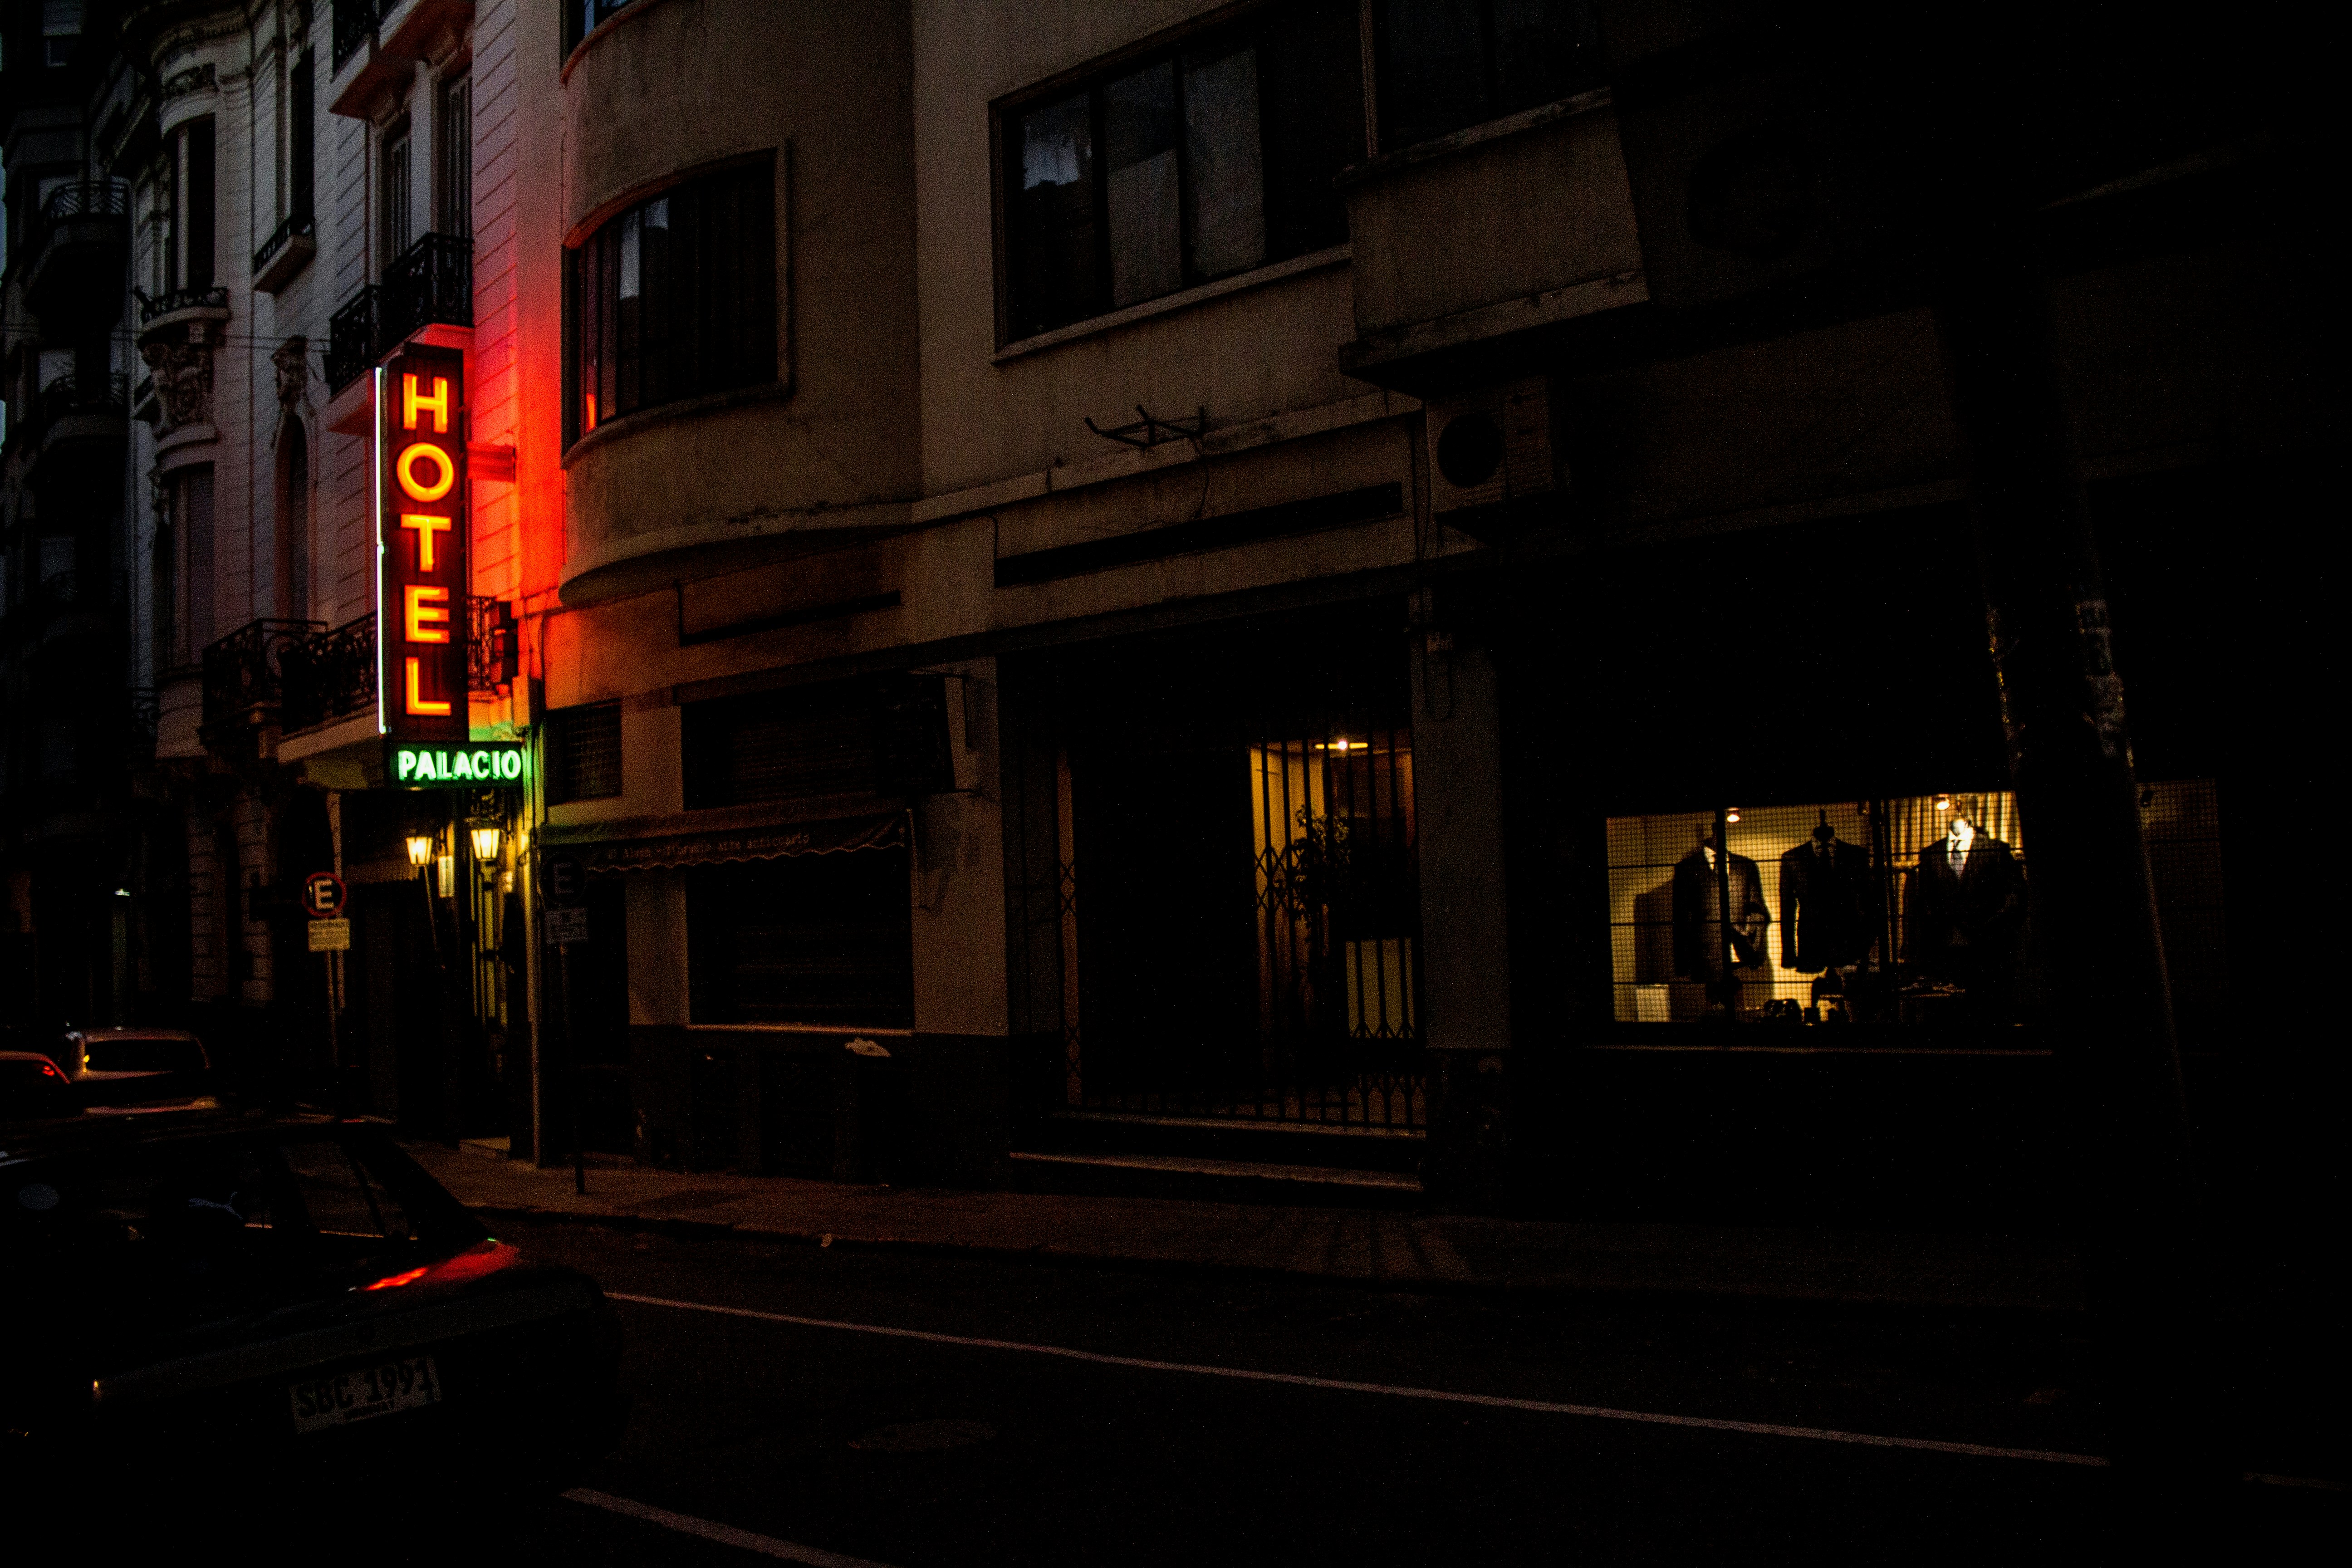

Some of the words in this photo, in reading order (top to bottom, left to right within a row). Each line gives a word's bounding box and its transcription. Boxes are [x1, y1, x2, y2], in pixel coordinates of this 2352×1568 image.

[397, 373, 454, 716] HOTEL
[398, 750, 521, 780] PALACIO
[314, 878, 334, 910] E
[553, 862, 574, 895] E
[297, 1377, 353, 1417] SBC
[365, 1359, 435, 1402] 1991
